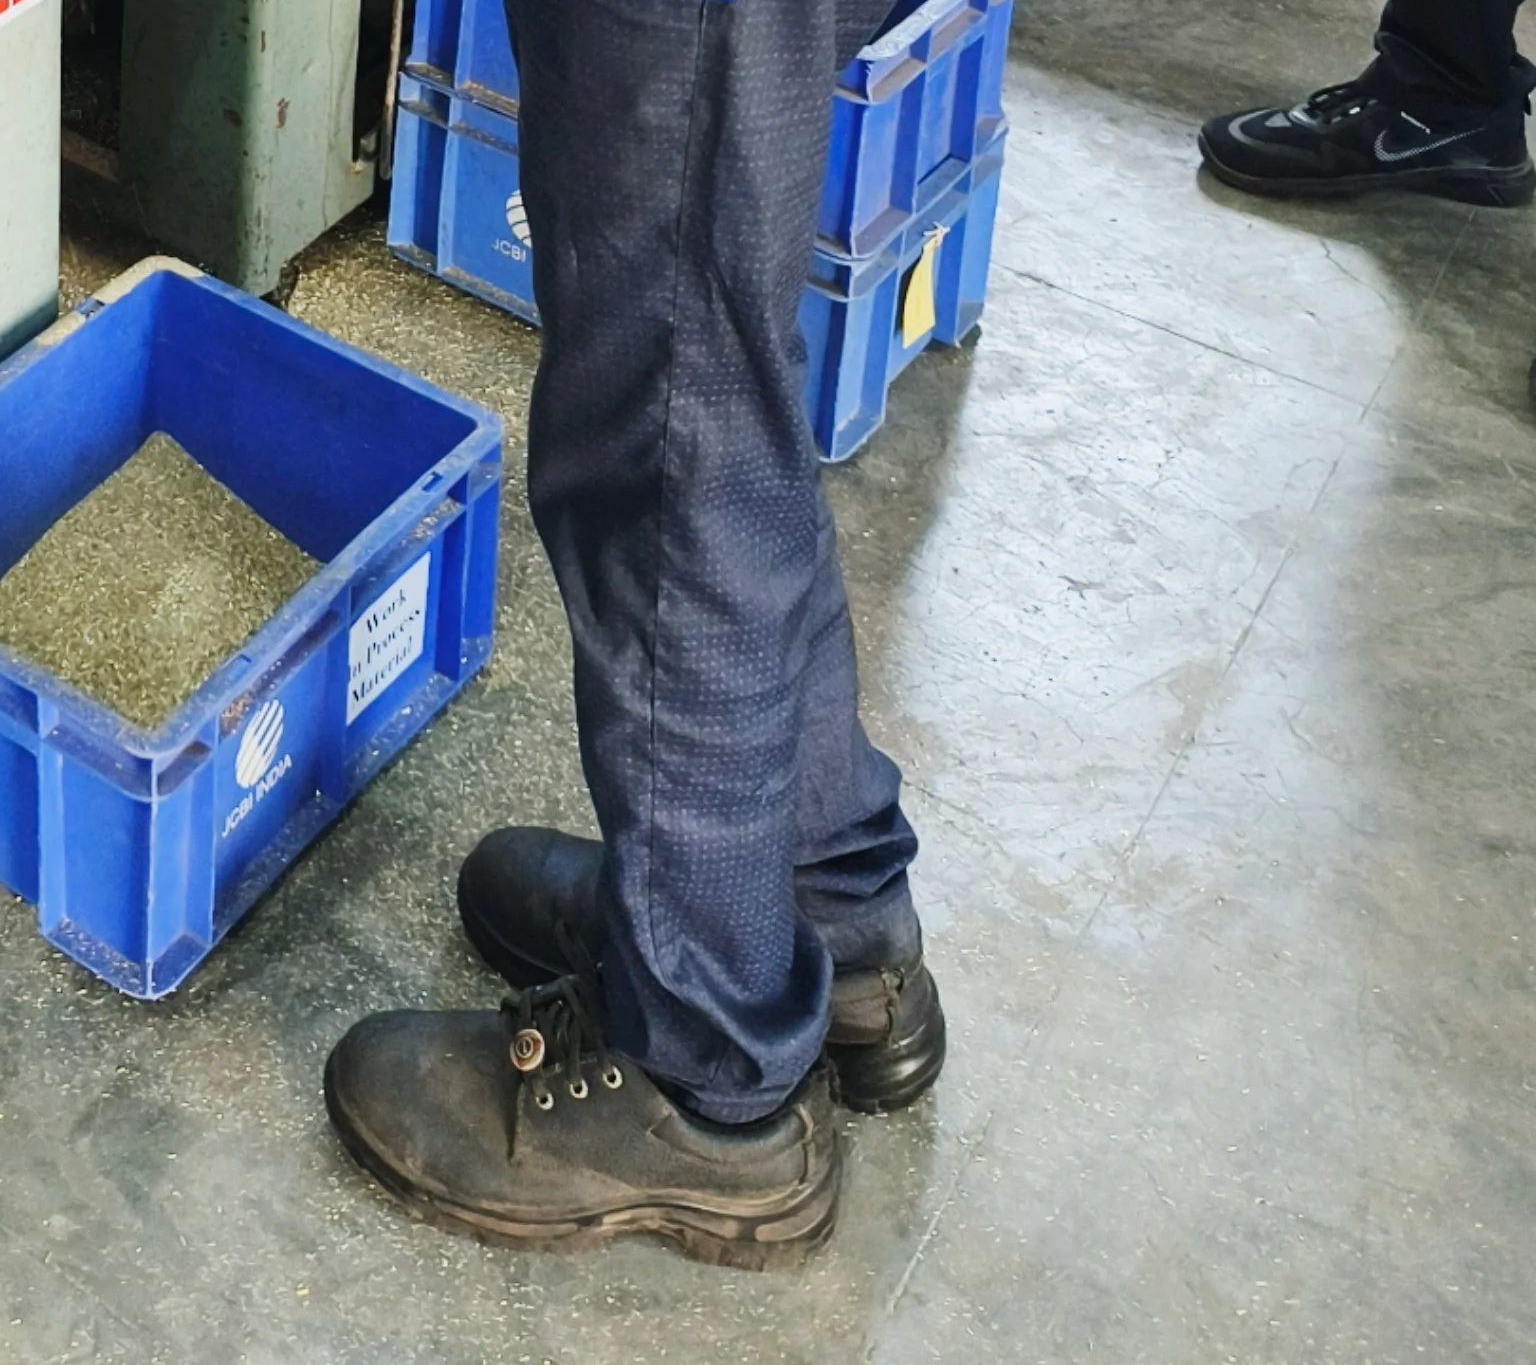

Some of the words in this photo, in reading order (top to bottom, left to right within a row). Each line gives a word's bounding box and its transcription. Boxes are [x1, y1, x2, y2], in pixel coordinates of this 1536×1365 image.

[492, 238, 526, 262] JCBI
[366, 589, 406, 633] Work
[221, 791, 253, 838] JCBI
[255, 753, 292, 803] INDIA
